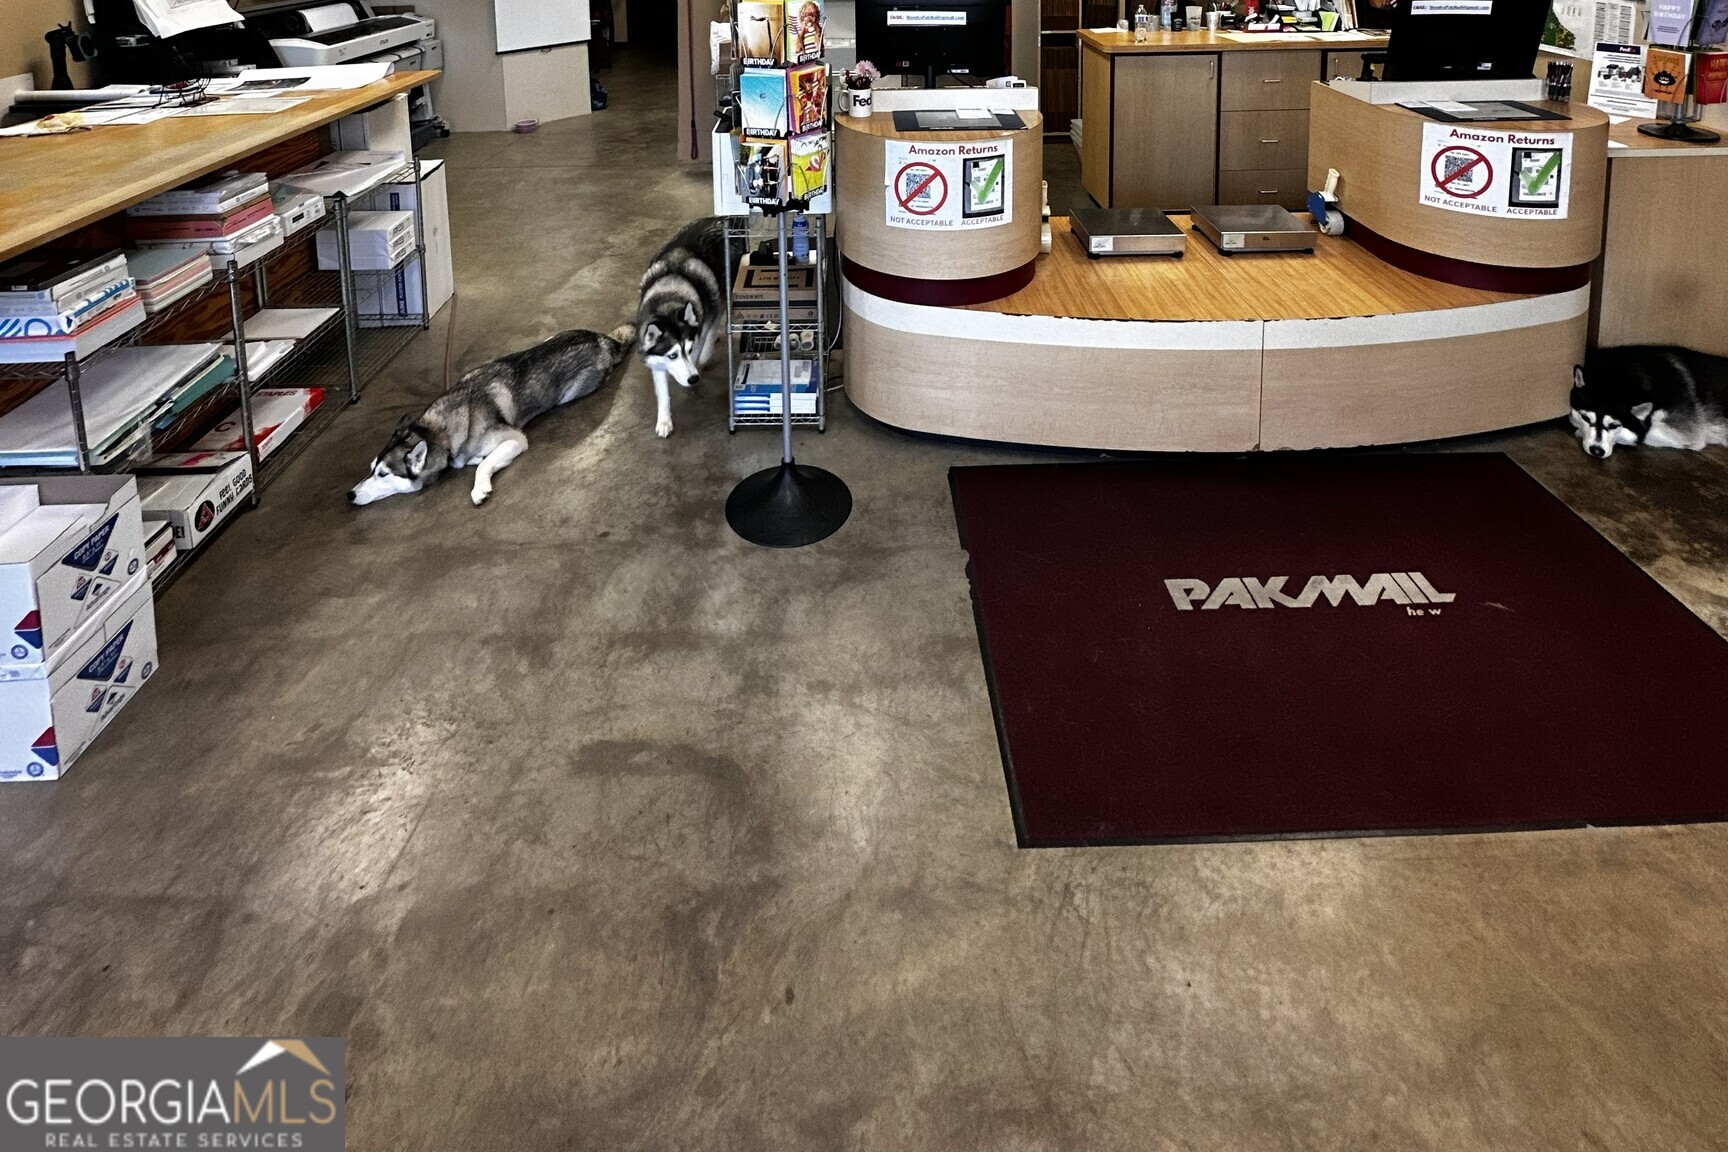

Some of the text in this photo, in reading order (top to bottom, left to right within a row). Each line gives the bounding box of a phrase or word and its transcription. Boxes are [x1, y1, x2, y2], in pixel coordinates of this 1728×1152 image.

[743, 58, 774, 66] BIRTHDAY
[746, 128, 778, 136] BIRTHDAY
[1450, 129, 1555, 145] Amazon Returns
[909, 145, 998, 156] Amazon Returns
[1424, 195, 1498, 213] NOT ACCEPTABLE
[1506, 208, 1557, 216] ACCEPTABLE
[890, 216, 953, 227] NOT ACCEPTABLE
[961, 215, 1004, 226] ACCEPTABLE
[1164, 572, 1456, 610] PAKMAIL
